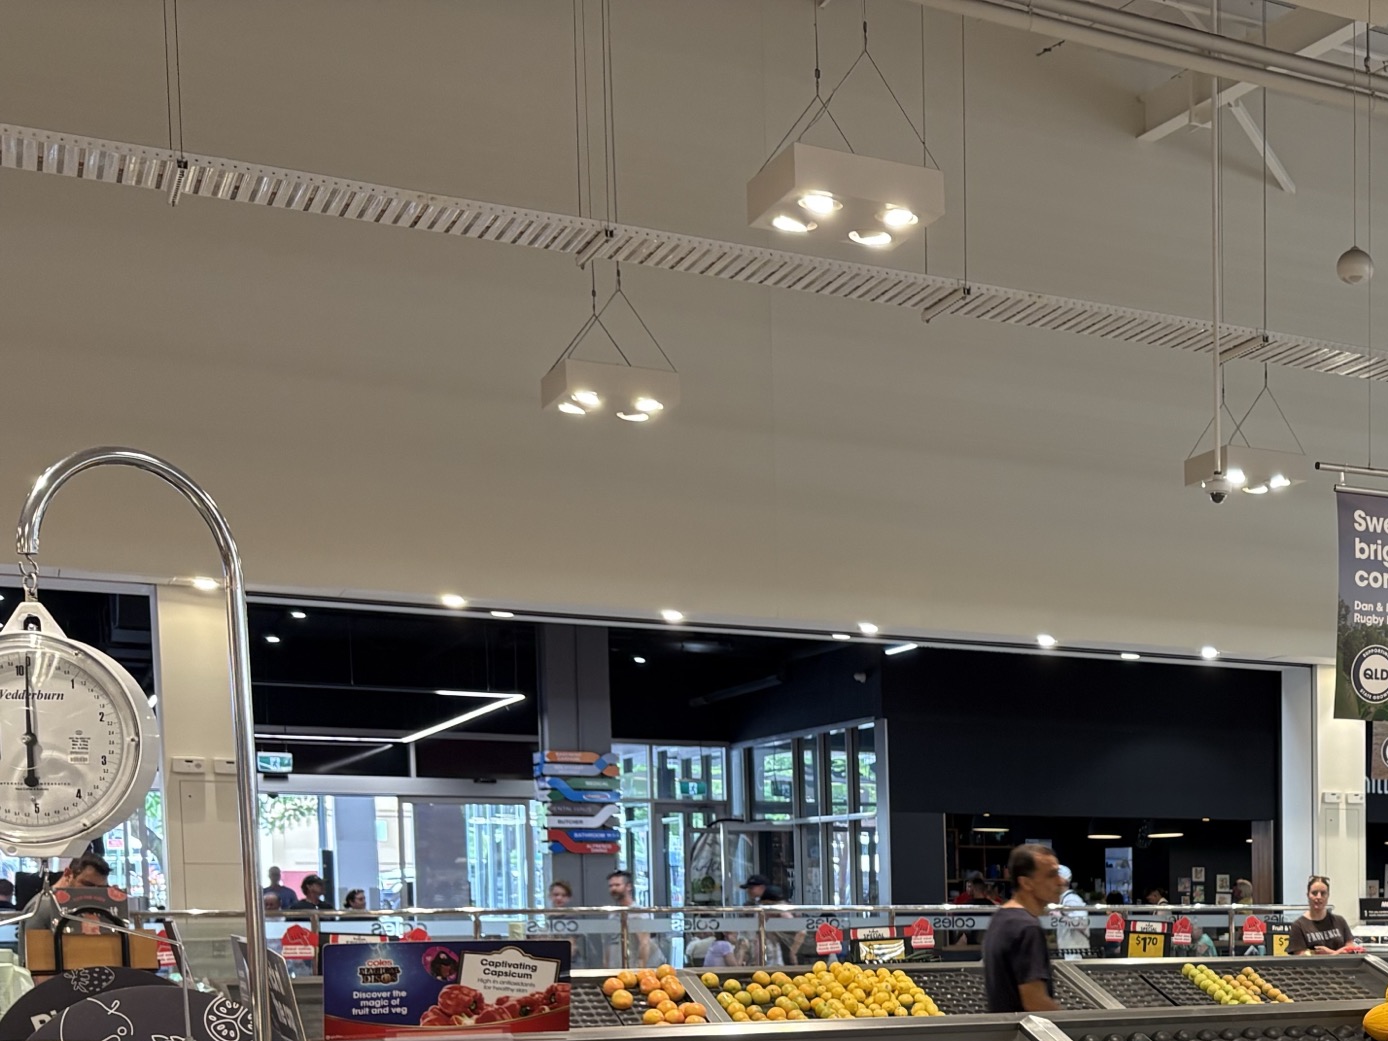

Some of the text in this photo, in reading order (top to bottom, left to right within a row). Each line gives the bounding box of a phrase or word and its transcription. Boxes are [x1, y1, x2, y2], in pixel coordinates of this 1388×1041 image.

[1354, 601, 1374, 612] Dan
[1376, 604, 1383, 612] &
[1354, 613, 1384, 626] Rugby
[15, 665, 24, 676] 10
[1363, 668, 1388, 681] QLD
[99, 712, 105, 722] 2
[102, 756, 107, 766] 3
[76, 789, 82, 799] 4
[35, 803, 40, 814] 5
[367, 959, 392, 967] coles
[481, 958, 538, 972] Captivating
[483, 968, 532, 980] Capsicum
[478, 978, 496, 986] High
[353, 990, 407, 1000] Discover the
[361, 998, 400, 1008] magic of
[352, 1006, 407, 1016] fruit and veg
